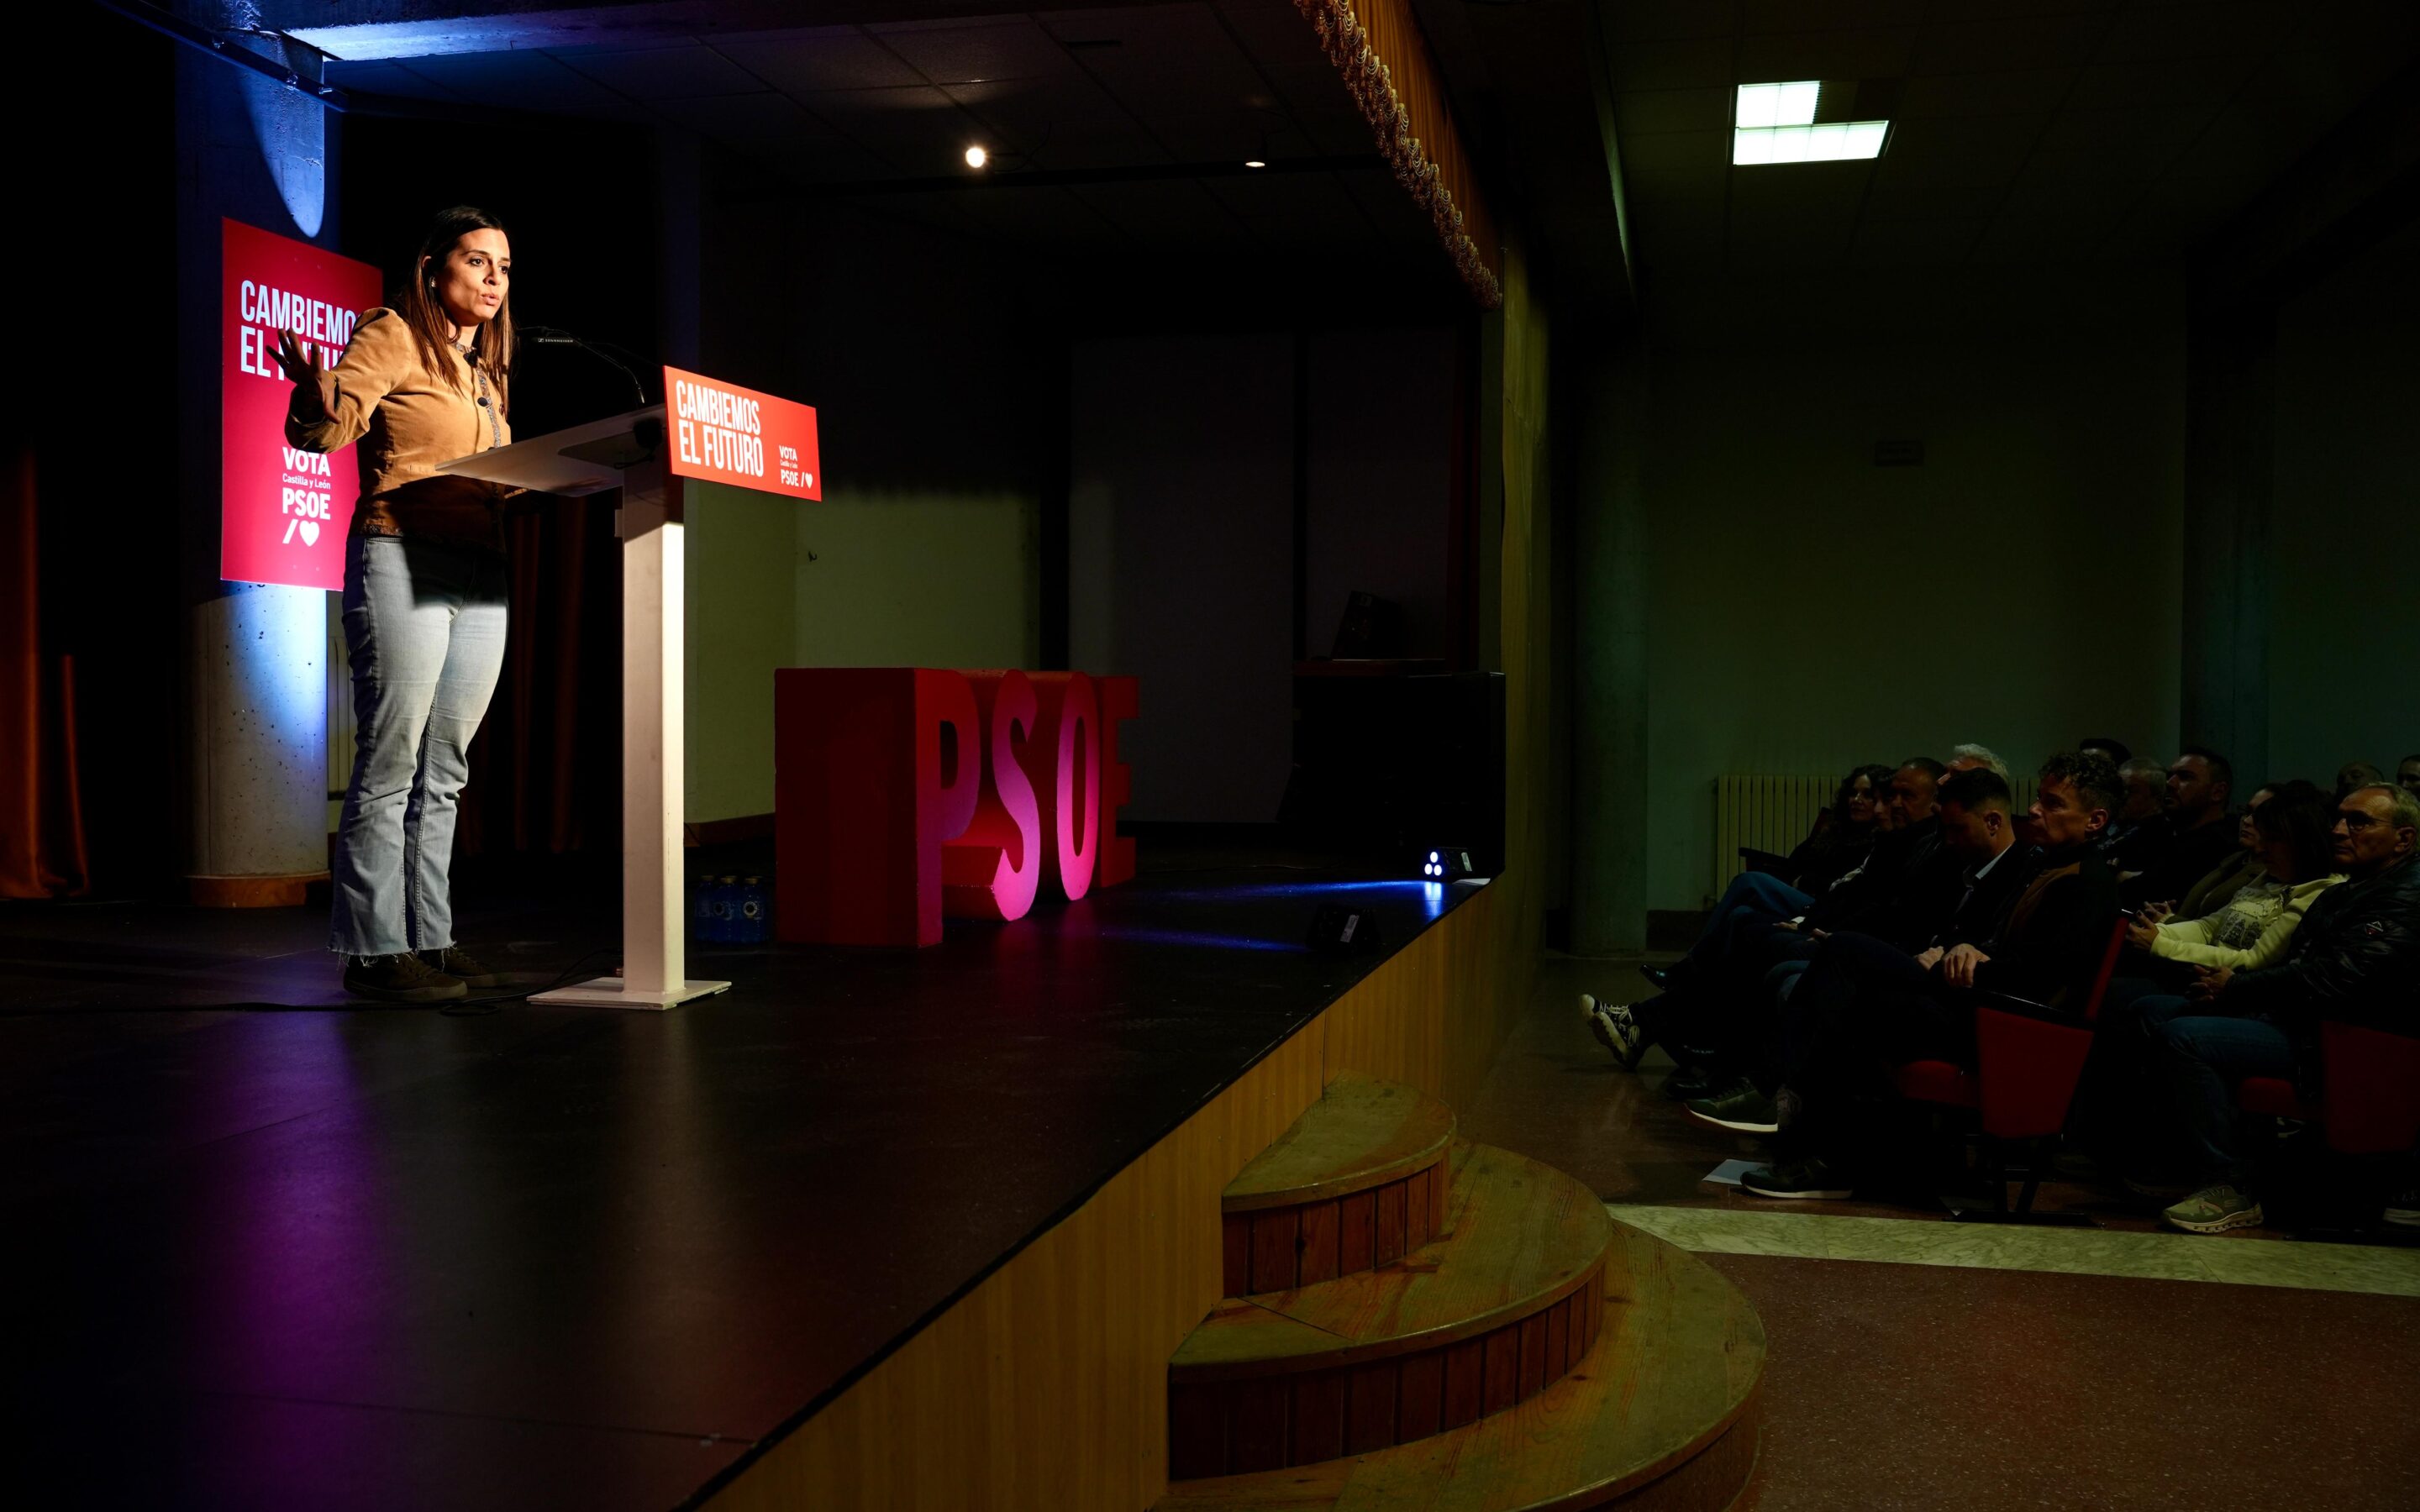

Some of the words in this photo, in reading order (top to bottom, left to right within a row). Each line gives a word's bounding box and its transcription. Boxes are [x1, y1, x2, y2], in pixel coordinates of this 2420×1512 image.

[241, 280, 361, 345] CAMBIEMO
[241, 325, 271, 378] EL
[676, 380, 760, 435] CAMBIEMOS
[282, 446, 331, 476] VOTA
[678, 419, 701, 465] EL
[702, 425, 764, 477] FUTURO
[779, 445, 797, 461] VOTA
[282, 473, 308, 486] Castilla
[309, 480, 313, 489] y
[314, 478, 331, 490] León
[781, 469, 799, 487] PSOE
[282, 487, 331, 520] PSOE
[915, 669, 1139, 948] PSOE
